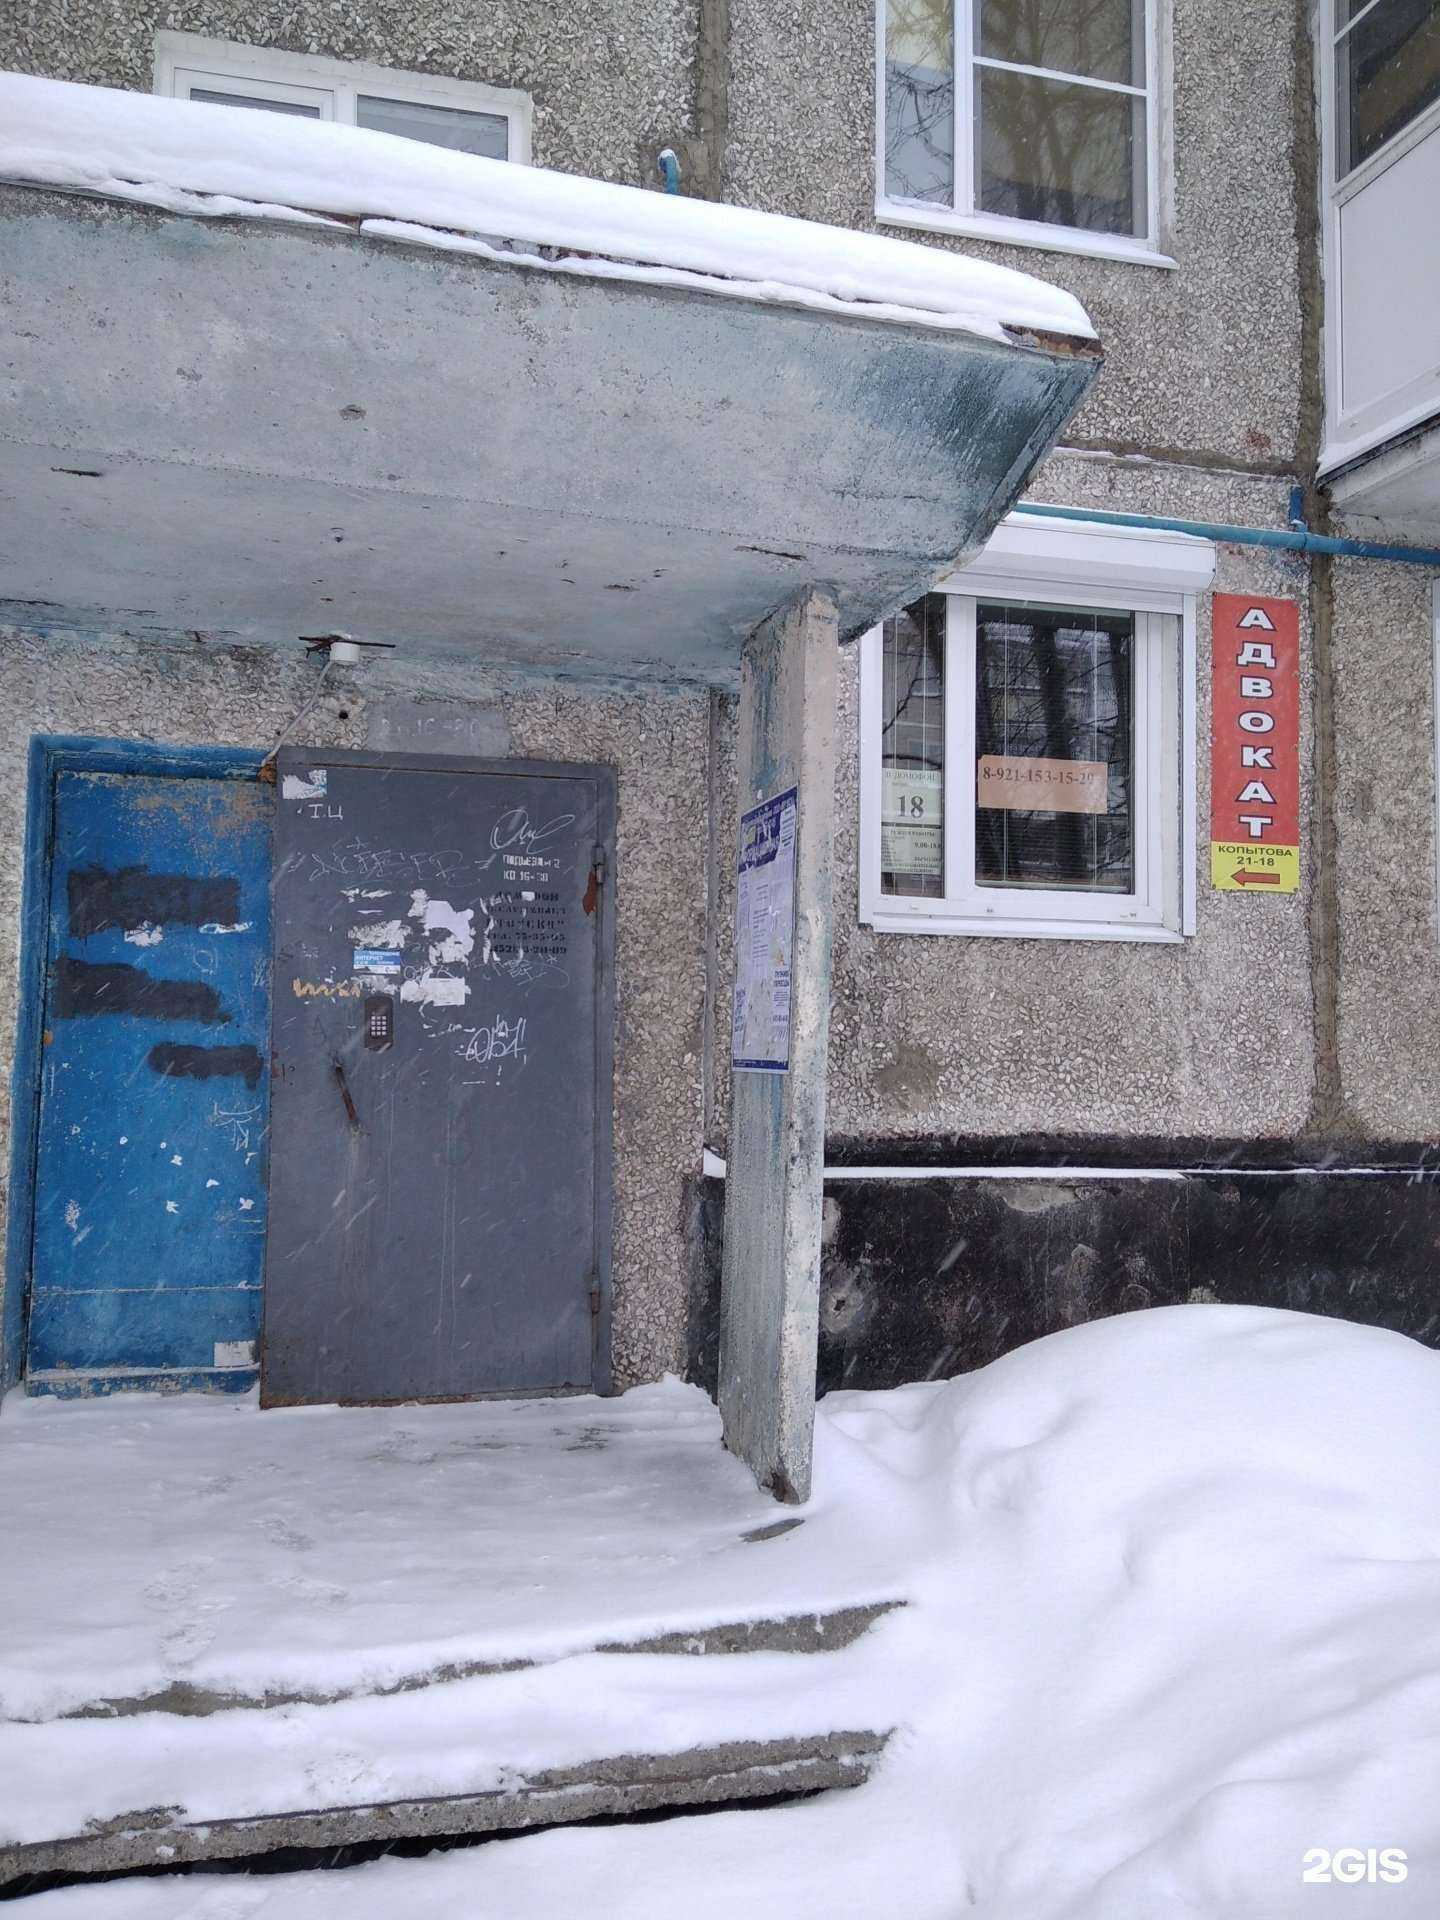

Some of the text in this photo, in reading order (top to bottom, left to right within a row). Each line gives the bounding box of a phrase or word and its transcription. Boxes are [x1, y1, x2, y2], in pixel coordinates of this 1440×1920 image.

[1236, 607, 1277, 839] АДВОКАТ
[897, 795, 924, 818] 18
[1218, 845, 1292, 856] КОПЫТОВА
[1237, 856, 1275, 866] 21-18
